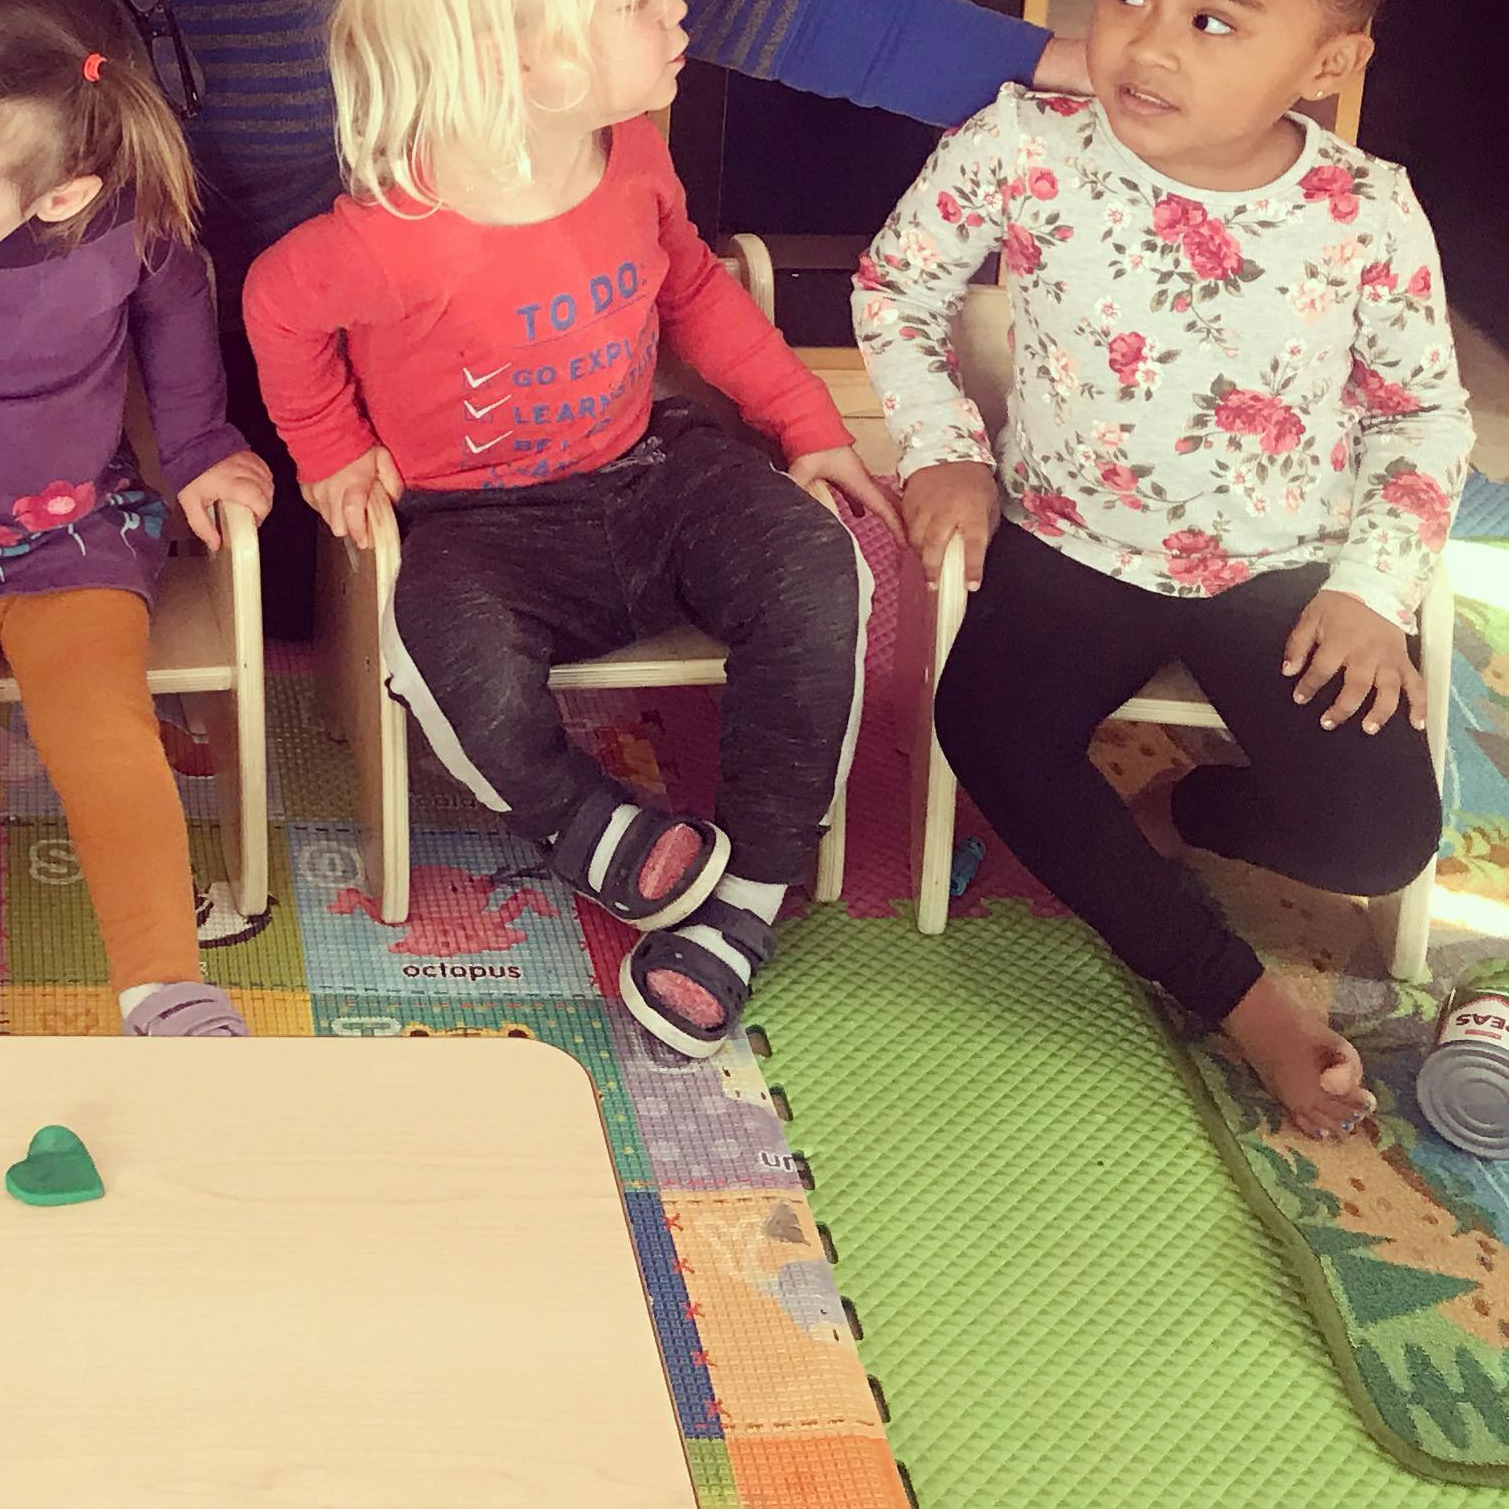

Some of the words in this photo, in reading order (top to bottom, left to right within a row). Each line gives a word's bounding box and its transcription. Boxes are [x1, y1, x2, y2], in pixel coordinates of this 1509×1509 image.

[516, 294, 576, 340] TO
[512, 366, 557, 387] GO
[402, 962, 522, 982] octopus
[1455, 1013, 1509, 1032] EAS
